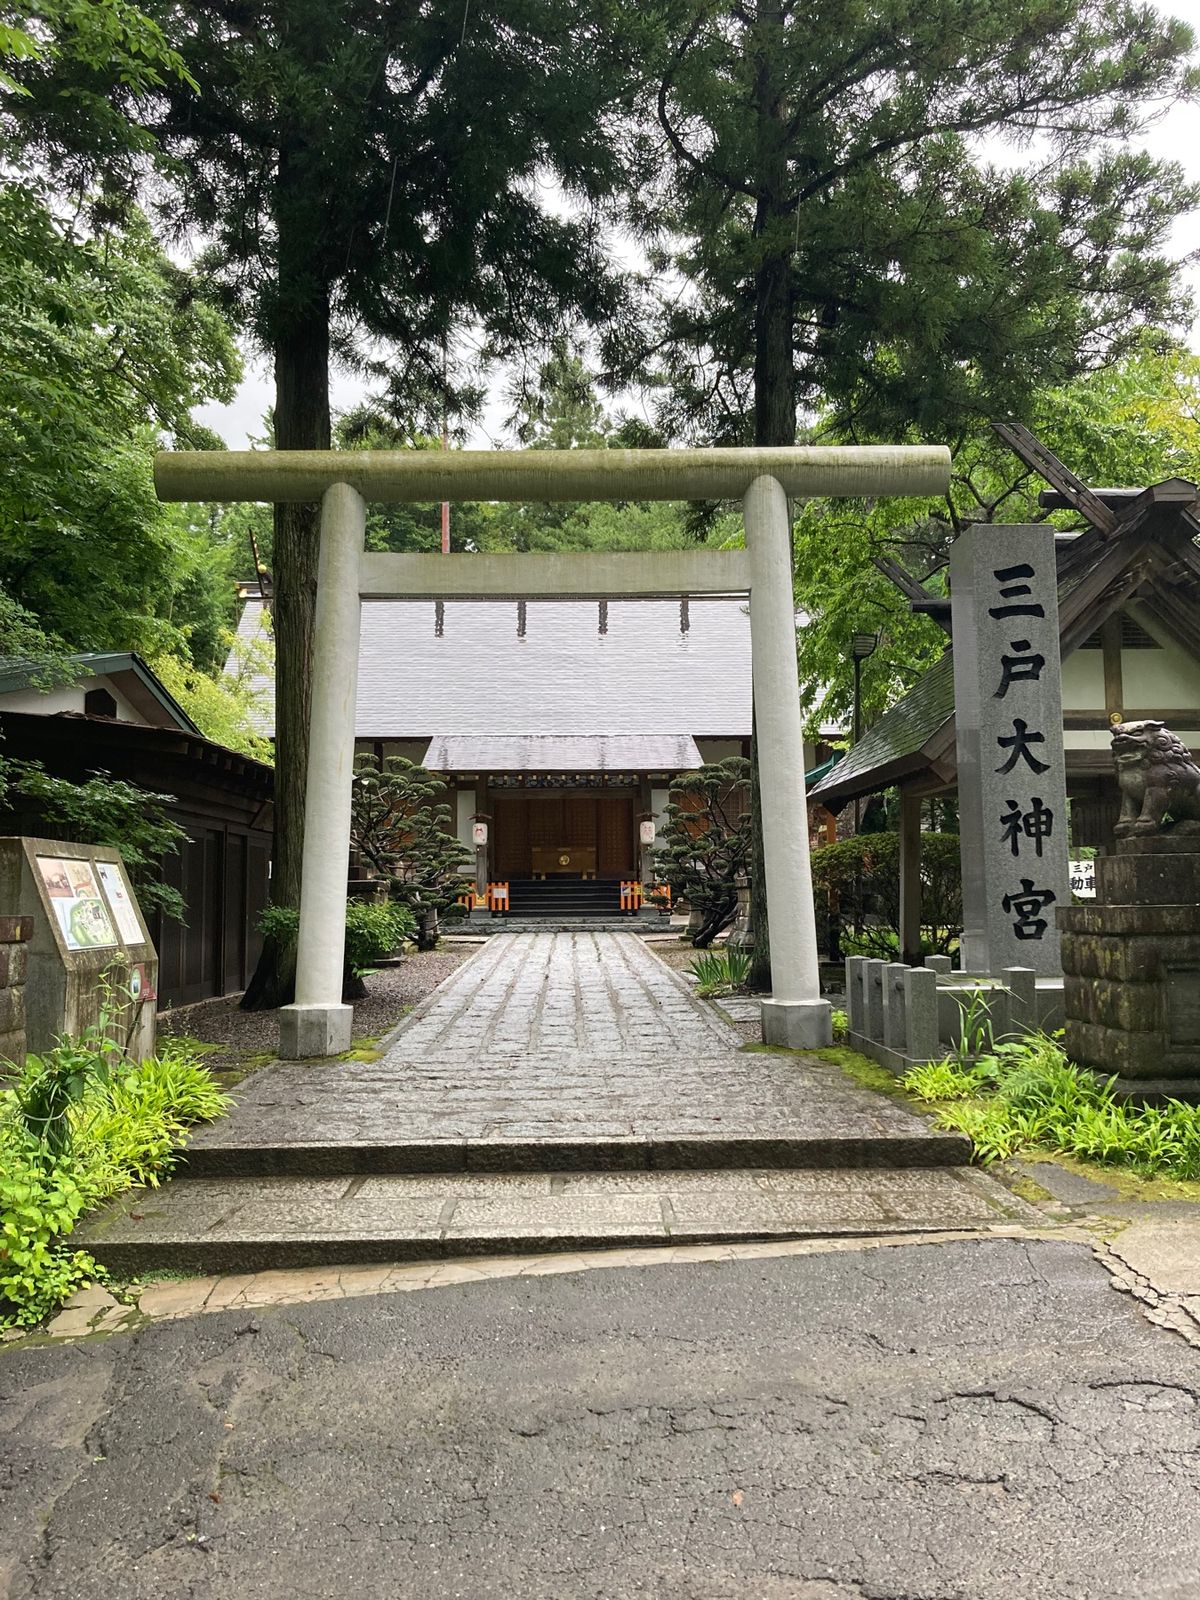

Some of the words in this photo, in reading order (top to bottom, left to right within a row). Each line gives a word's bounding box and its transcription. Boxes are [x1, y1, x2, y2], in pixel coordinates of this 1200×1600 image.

[988, 563, 1057, 941] 三戸大神宮
